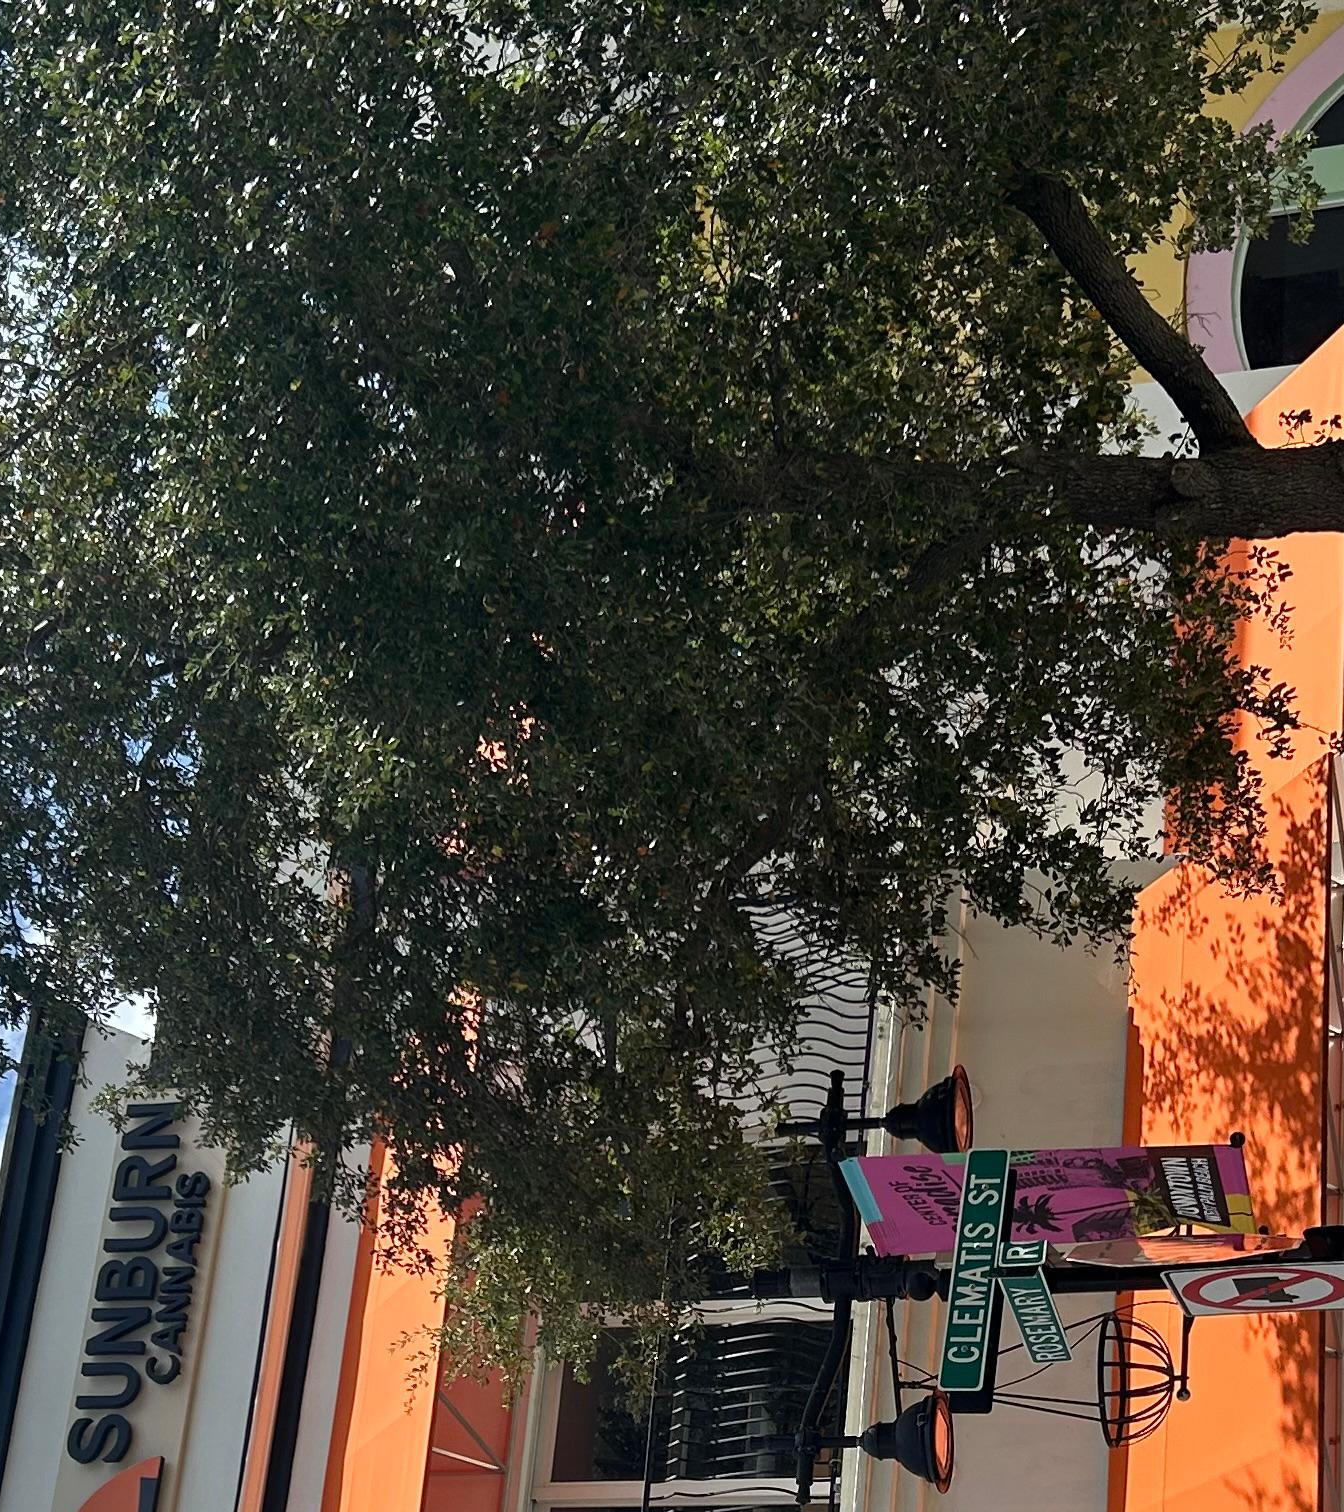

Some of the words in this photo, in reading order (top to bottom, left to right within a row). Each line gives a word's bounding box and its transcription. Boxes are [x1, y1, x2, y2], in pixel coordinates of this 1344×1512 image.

[889, 1181, 913, 1193] OF
[967, 1174, 1001, 1206] ST
[1191, 1157, 1212, 1184] BEACH
[1197, 1184, 1216, 1204] PALM
[902, 1195, 947, 1225] CENTER
[903, 1166, 960, 1233] radise
[67, 1102, 181, 1464] SUNBURN
[145, 1171, 210, 1385] CANNABIS
[947, 1223, 995, 1363] CLEMATIS
[1008, 1288, 1067, 1360] ROSEMARY
